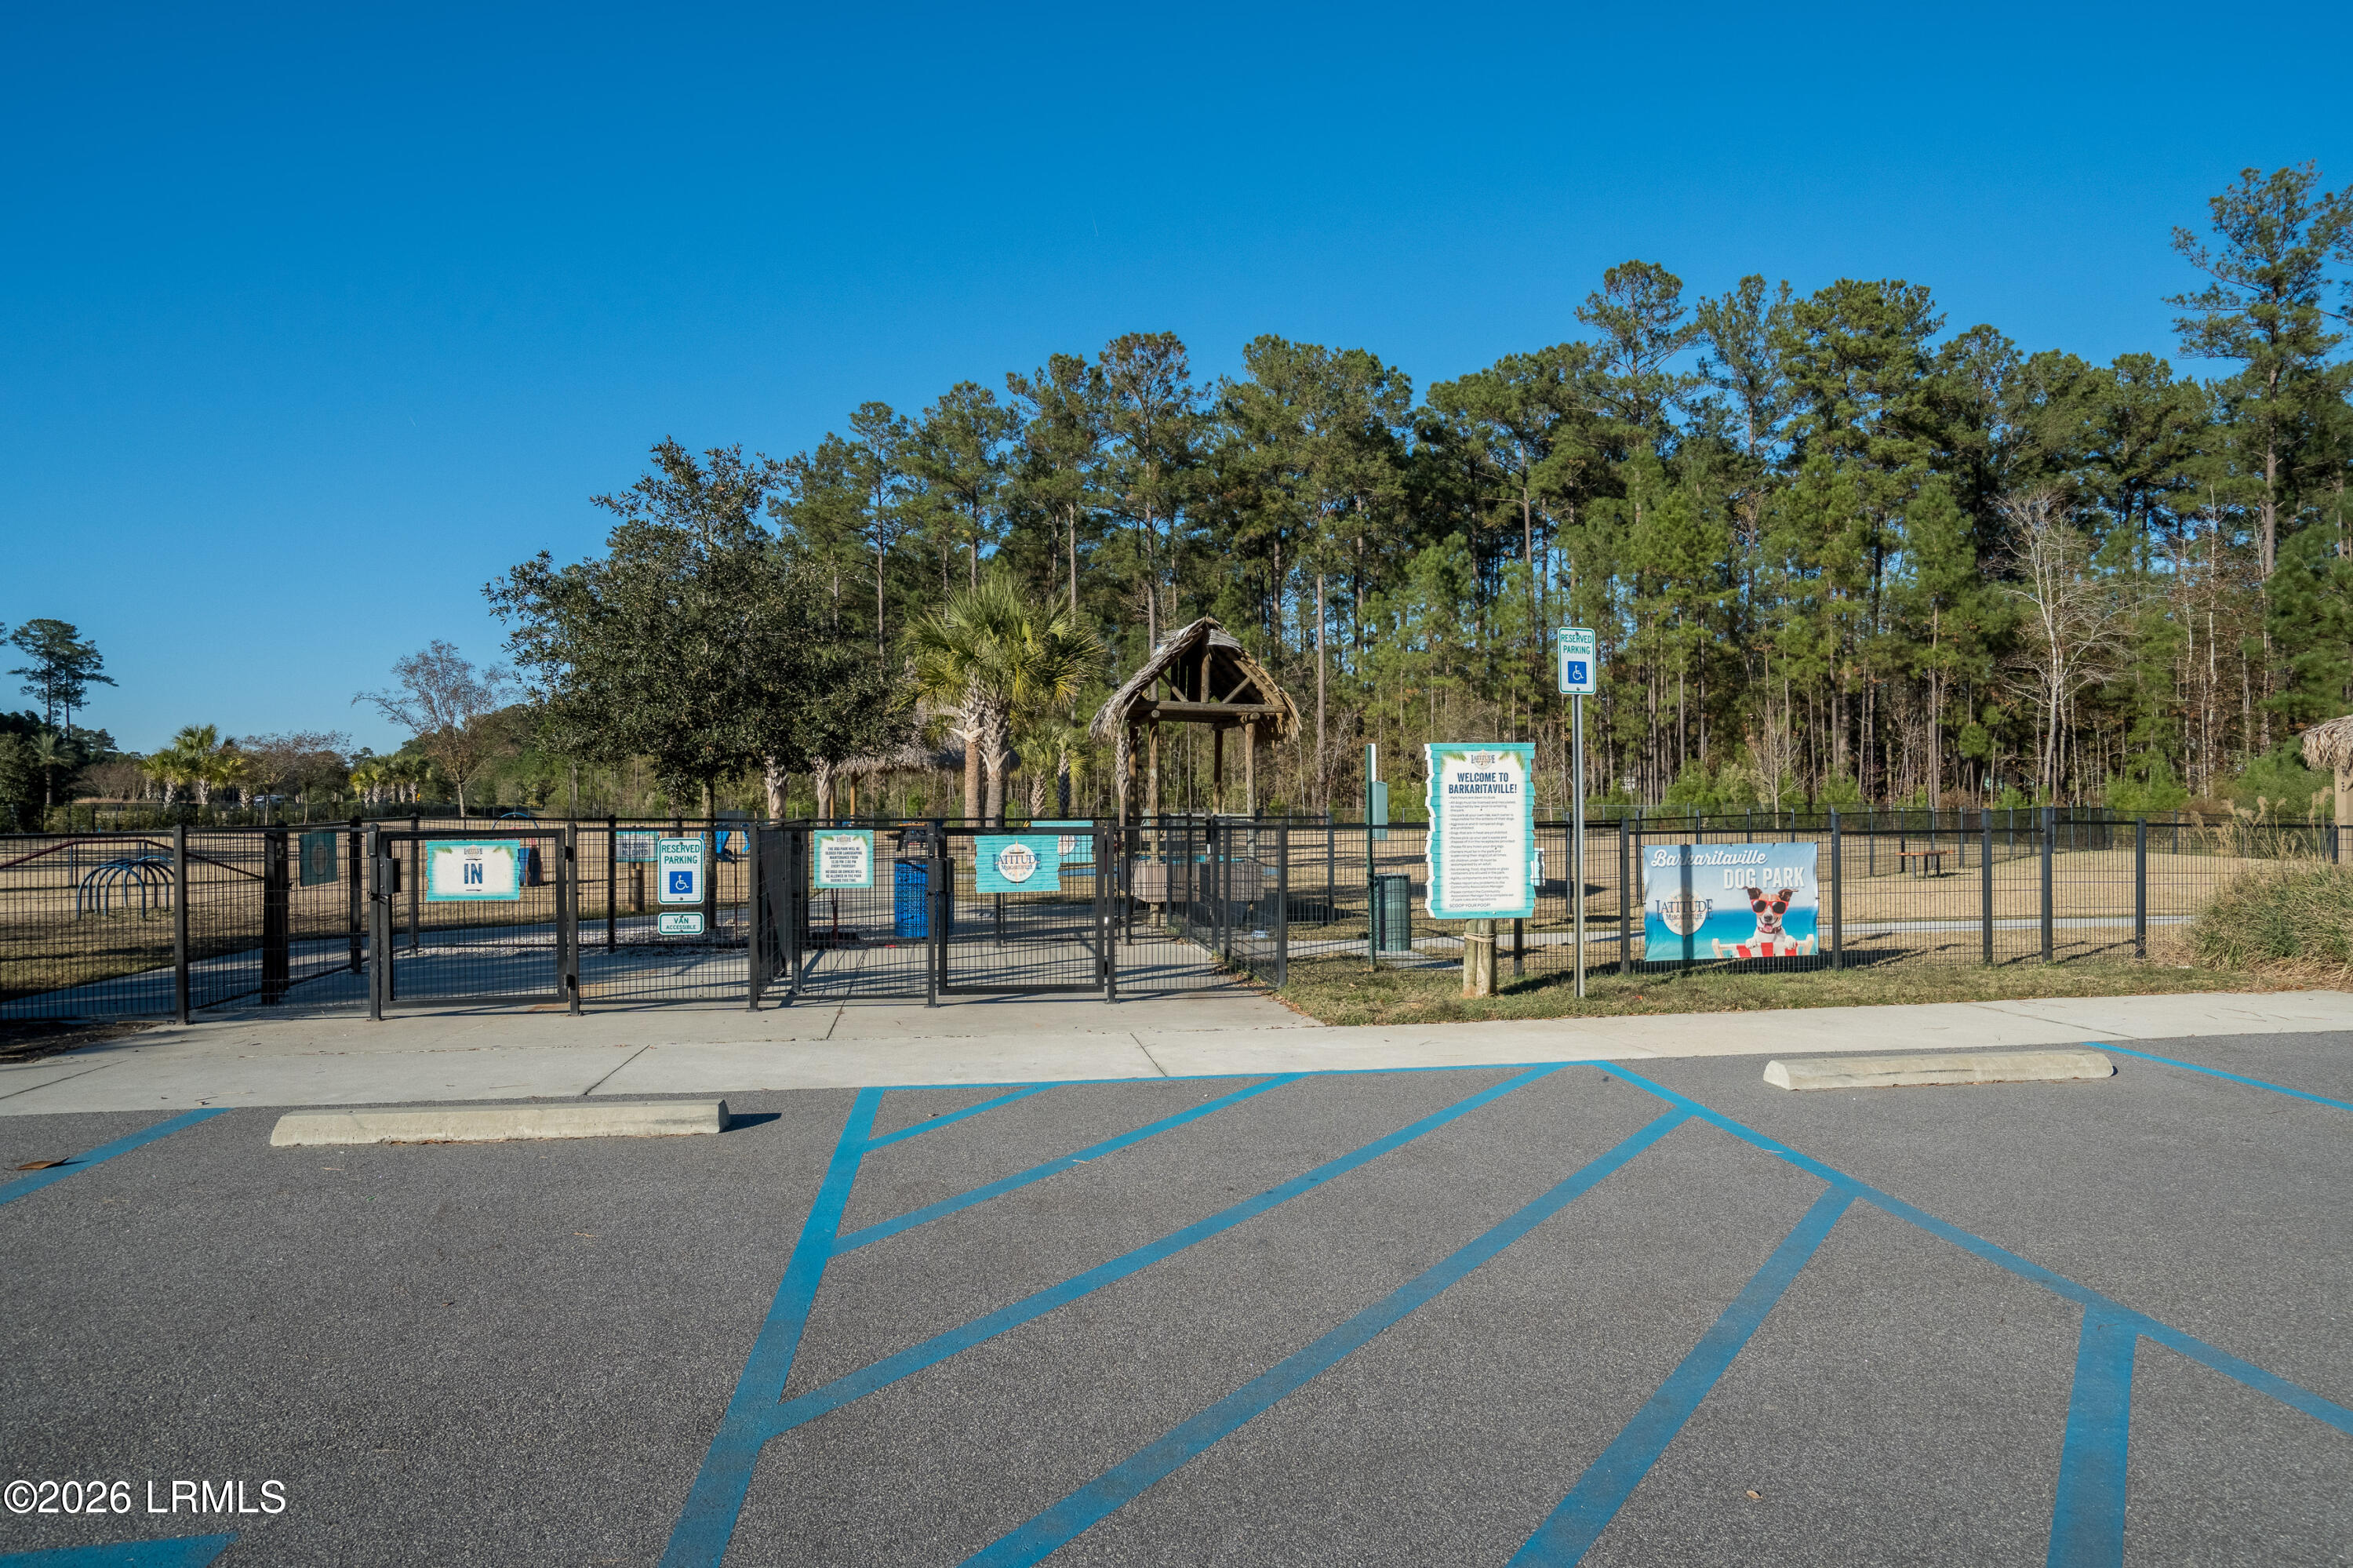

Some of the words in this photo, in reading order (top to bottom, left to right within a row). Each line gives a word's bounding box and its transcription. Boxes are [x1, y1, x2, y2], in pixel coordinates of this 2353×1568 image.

[1561, 634, 1592, 643] RESERVED
[1563, 646, 1590, 655] PARKING
[1457, 772, 1496, 782] WELCOME
[1499, 773, 1509, 782] TO
[1449, 784, 1517, 793] BARKARITAVILLE!
[993, 853, 1042, 871] LATITUDE
[1651, 849, 1767, 867] Barkaritaville
[464, 864, 483, 884] IN
[1724, 869, 1756, 889] DOG
[1764, 867, 1805, 888] PARK
[1656, 899, 1713, 921] LATITUDE
